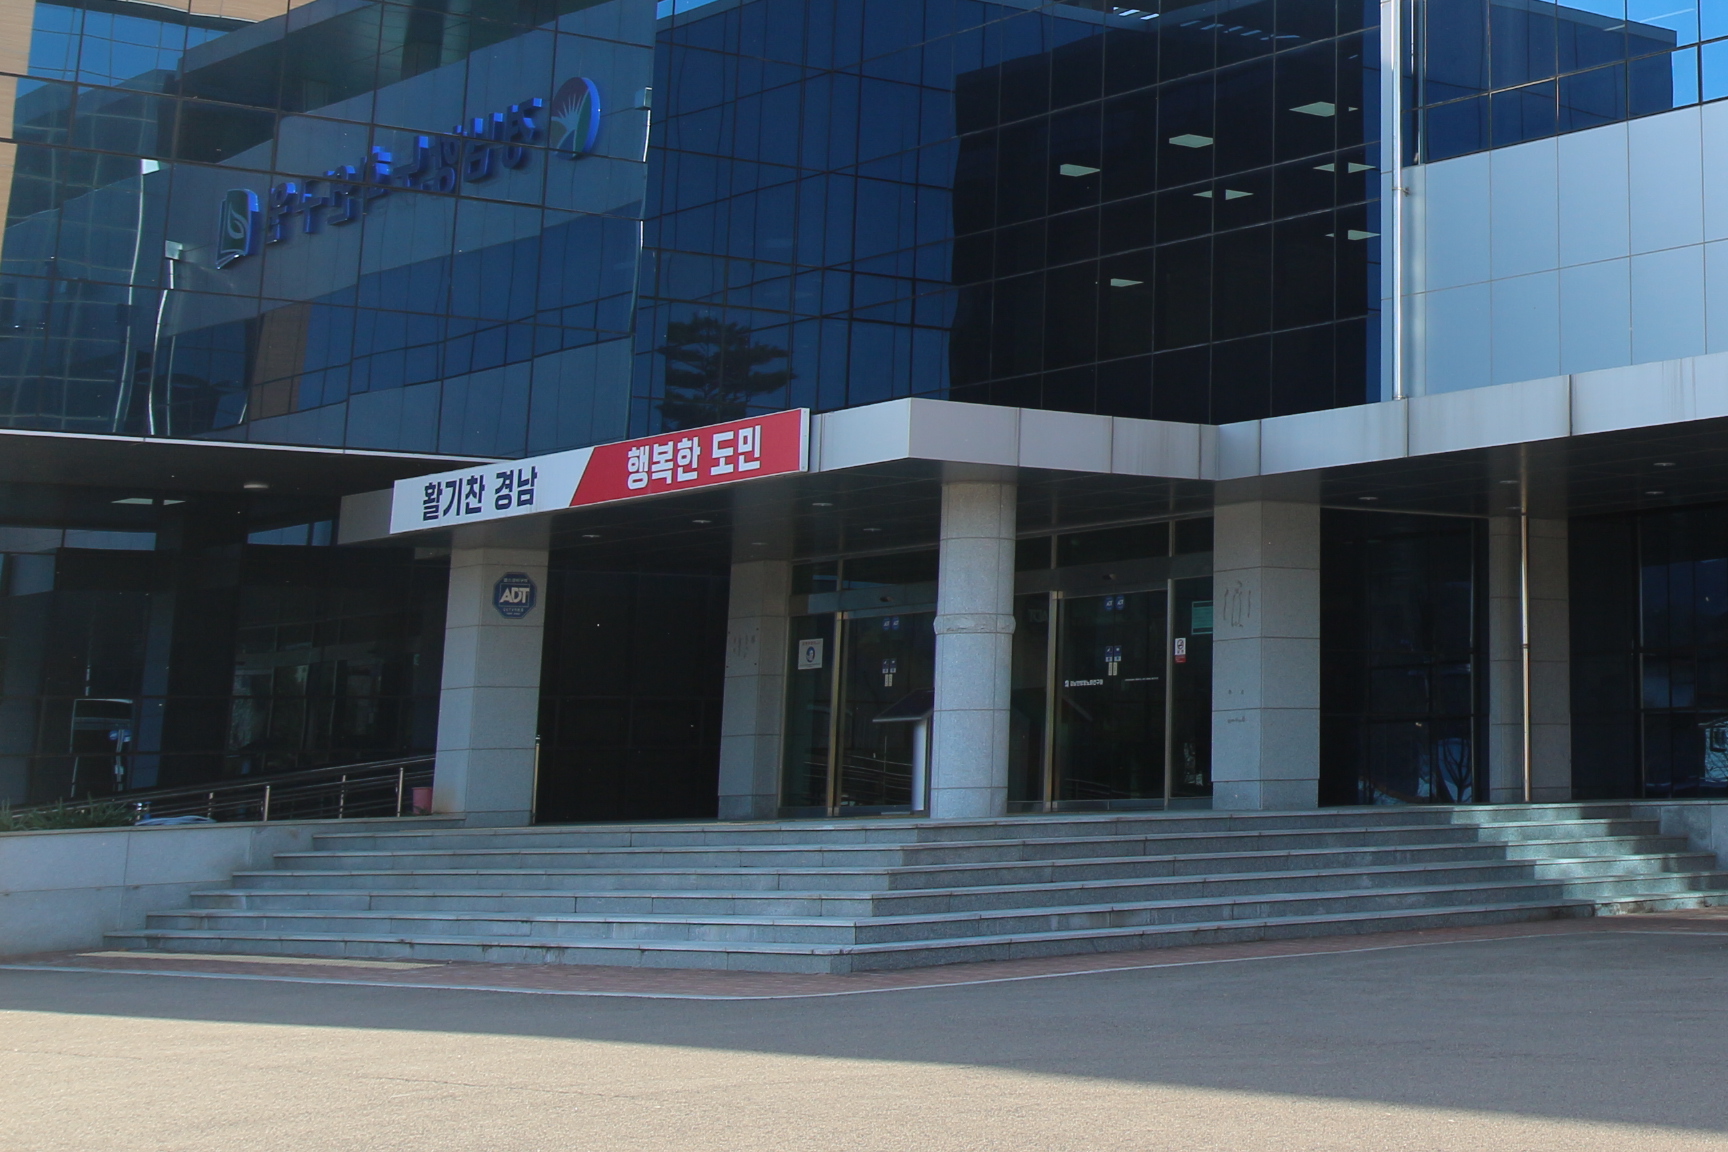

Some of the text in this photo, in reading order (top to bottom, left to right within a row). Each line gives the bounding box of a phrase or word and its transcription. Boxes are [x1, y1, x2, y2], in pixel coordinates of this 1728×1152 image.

[422, 425, 762, 522] 활기찬 경남 행복한 도민
[499, 587, 530, 604] ADT
